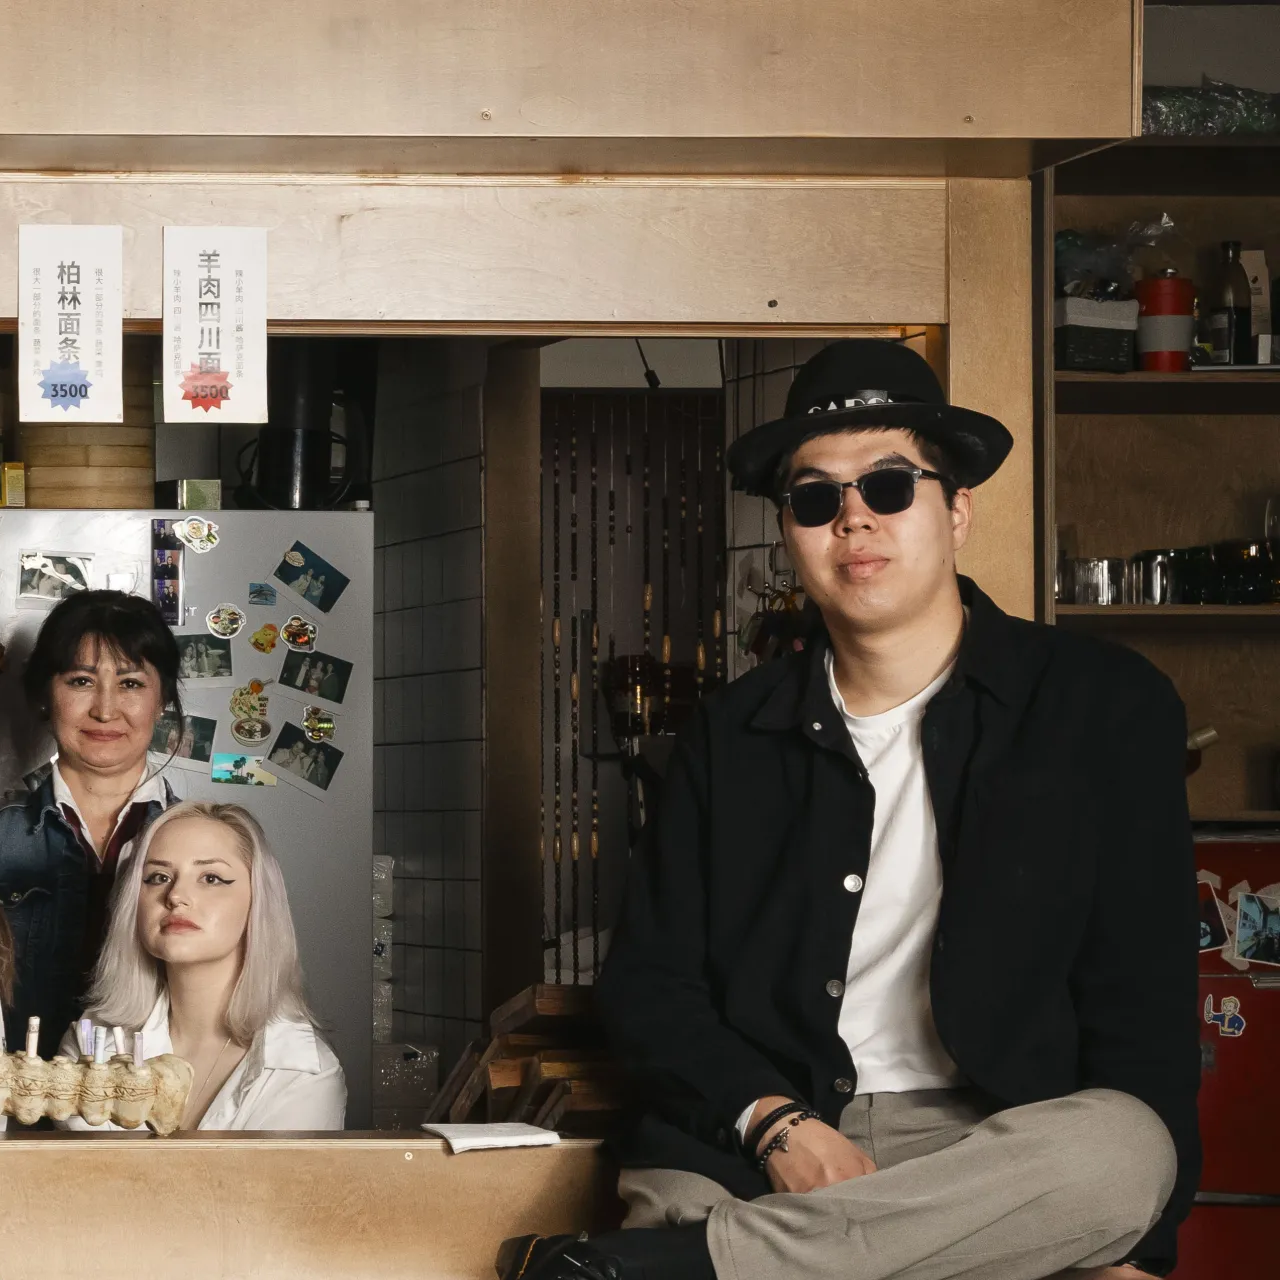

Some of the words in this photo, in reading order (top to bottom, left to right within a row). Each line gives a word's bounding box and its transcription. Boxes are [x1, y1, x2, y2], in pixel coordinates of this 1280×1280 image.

[57, 261, 81, 361] 柏林面条
[198, 250, 221, 374] 羊肉四川面
[51, 384, 88, 398] 3500
[192, 385, 229, 399] 3500
